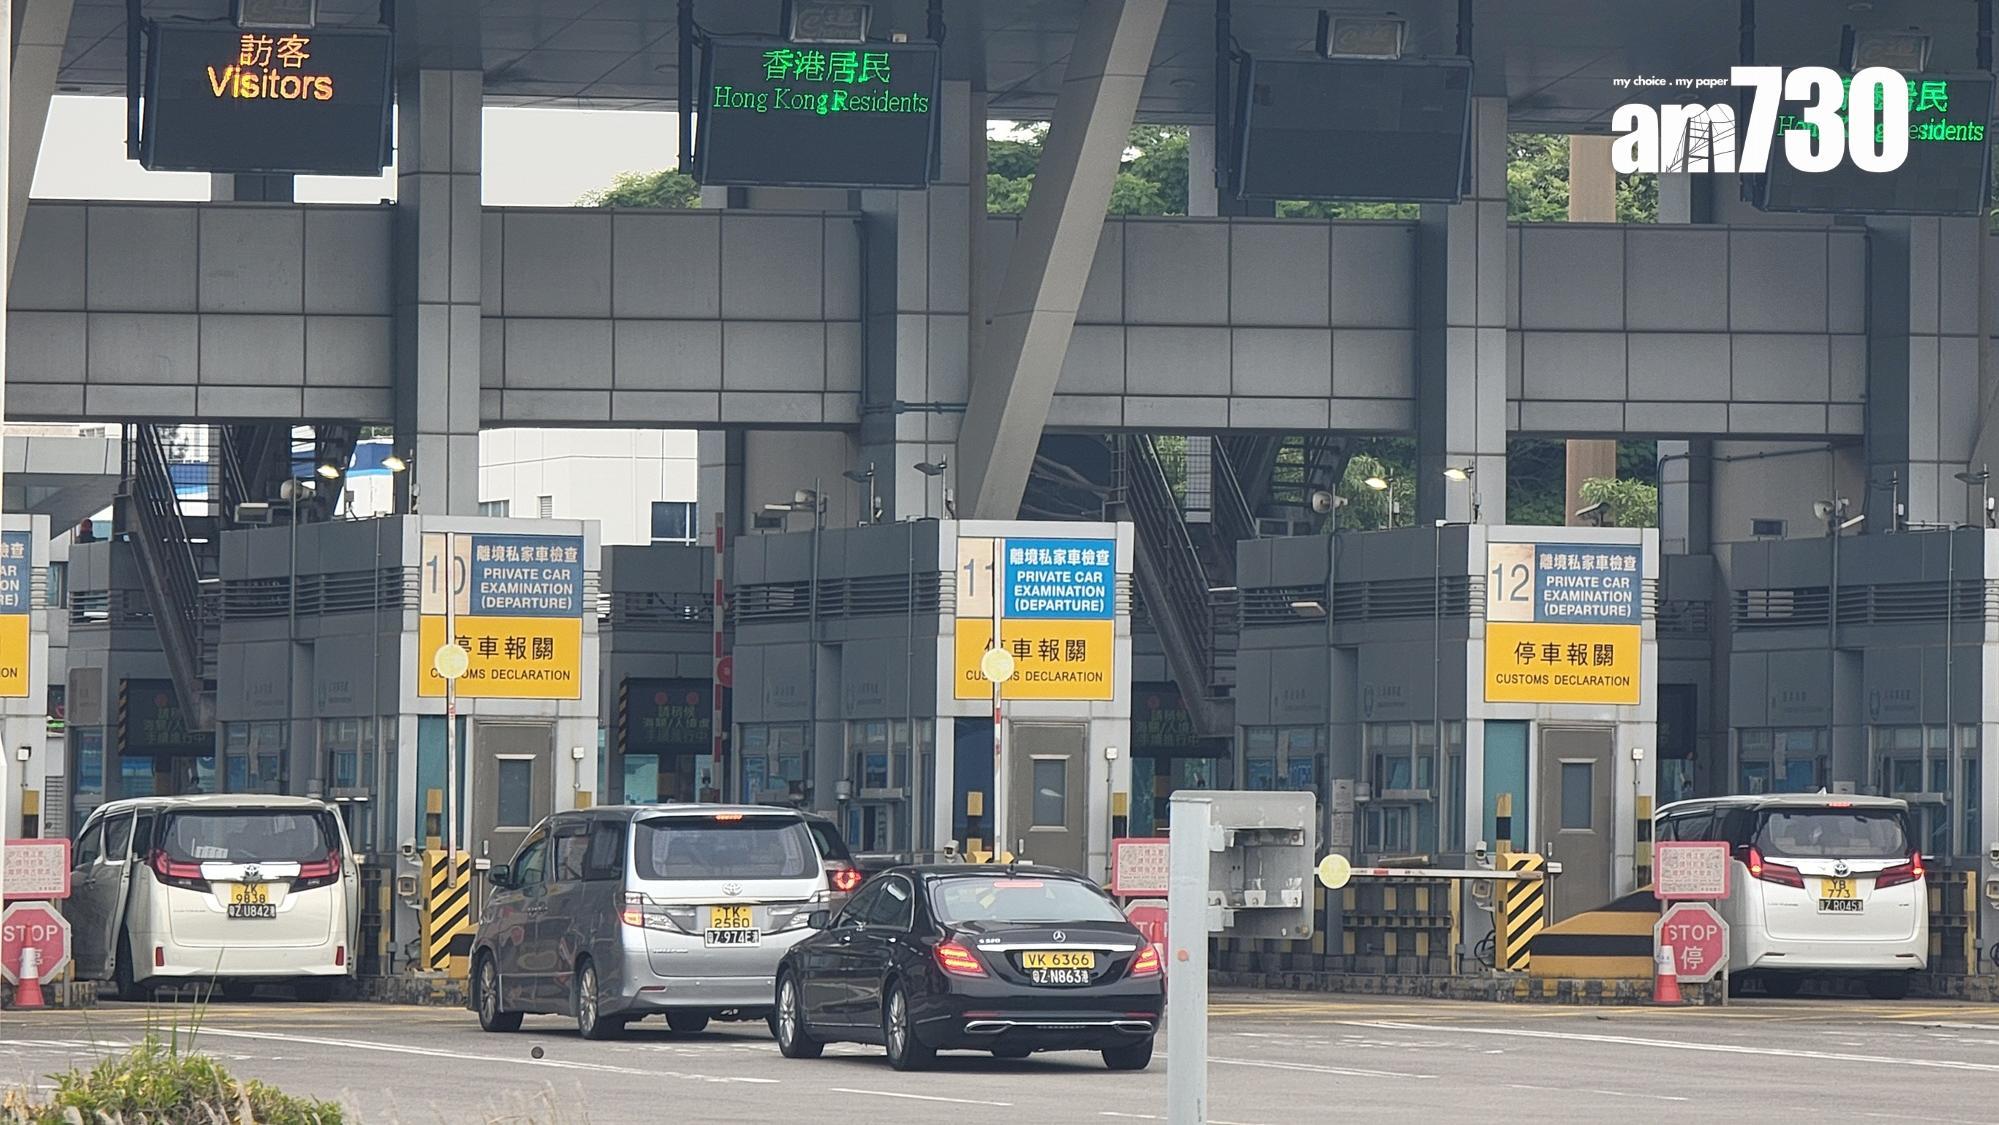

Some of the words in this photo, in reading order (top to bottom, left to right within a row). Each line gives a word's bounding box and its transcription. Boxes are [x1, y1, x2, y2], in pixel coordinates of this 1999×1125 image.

[240, 33, 311, 68] 訪客
[762, 49, 891, 84] 香港居民
[207, 64, 333, 100] Visitors
[713, 86, 769, 113] Hong
[773, 88, 829, 115] Kong
[830, 90, 929, 113] Residents
[1908, 118, 1985, 141] esidents
[476, 545, 578, 563] 離境私家車檢查
[1009, 548, 1110, 566] 離境私家車檢查
[1539, 554, 1637, 572] 離境私家車檢查
[483, 568, 539, 580] PRIVATE
[542, 569, 571, 581] CAR
[1017, 571, 1071, 583] PRIVATE
[1075, 572, 1102, 583] CAR
[480, 582, 573, 595] EXAMINATION
[1491, 563, 1530, 602] 12
[1546, 576, 1598, 588] PRIVATE
[1602, 577, 1630, 588] CAR
[1014, 585, 1105, 597] EXAMINATION
[1543, 590, 1632, 602] EXAMINATION
[481, 597, 572, 610] (DEPARTURE)
[1015, 599, 1104, 612] (DEPARTURE)
[1544, 604, 1631, 617] (DEPARTURE)
[1514, 641, 1614, 667] 停車報關
[491, 668, 571, 680] DECLARATION
[1025, 671, 1103, 682] DECLARATION
[1496, 673, 1549, 685] CUSTOMS
[1554, 674, 1630, 686] DECLARATION
[1831, 878, 1846, 890] YB
[235, 893, 266, 904] 9838
[1827, 889, 1851, 898] 773
[722, 906, 740, 918] TK
[714, 917, 750, 928] 2560
[3, 925, 59, 942] STOP
[1668, 924, 1718, 941] STOP
[1028, 954, 1047, 966] VK
[1052, 954, 1089, 966] 6366
[1680, 945, 1704, 970] 停
